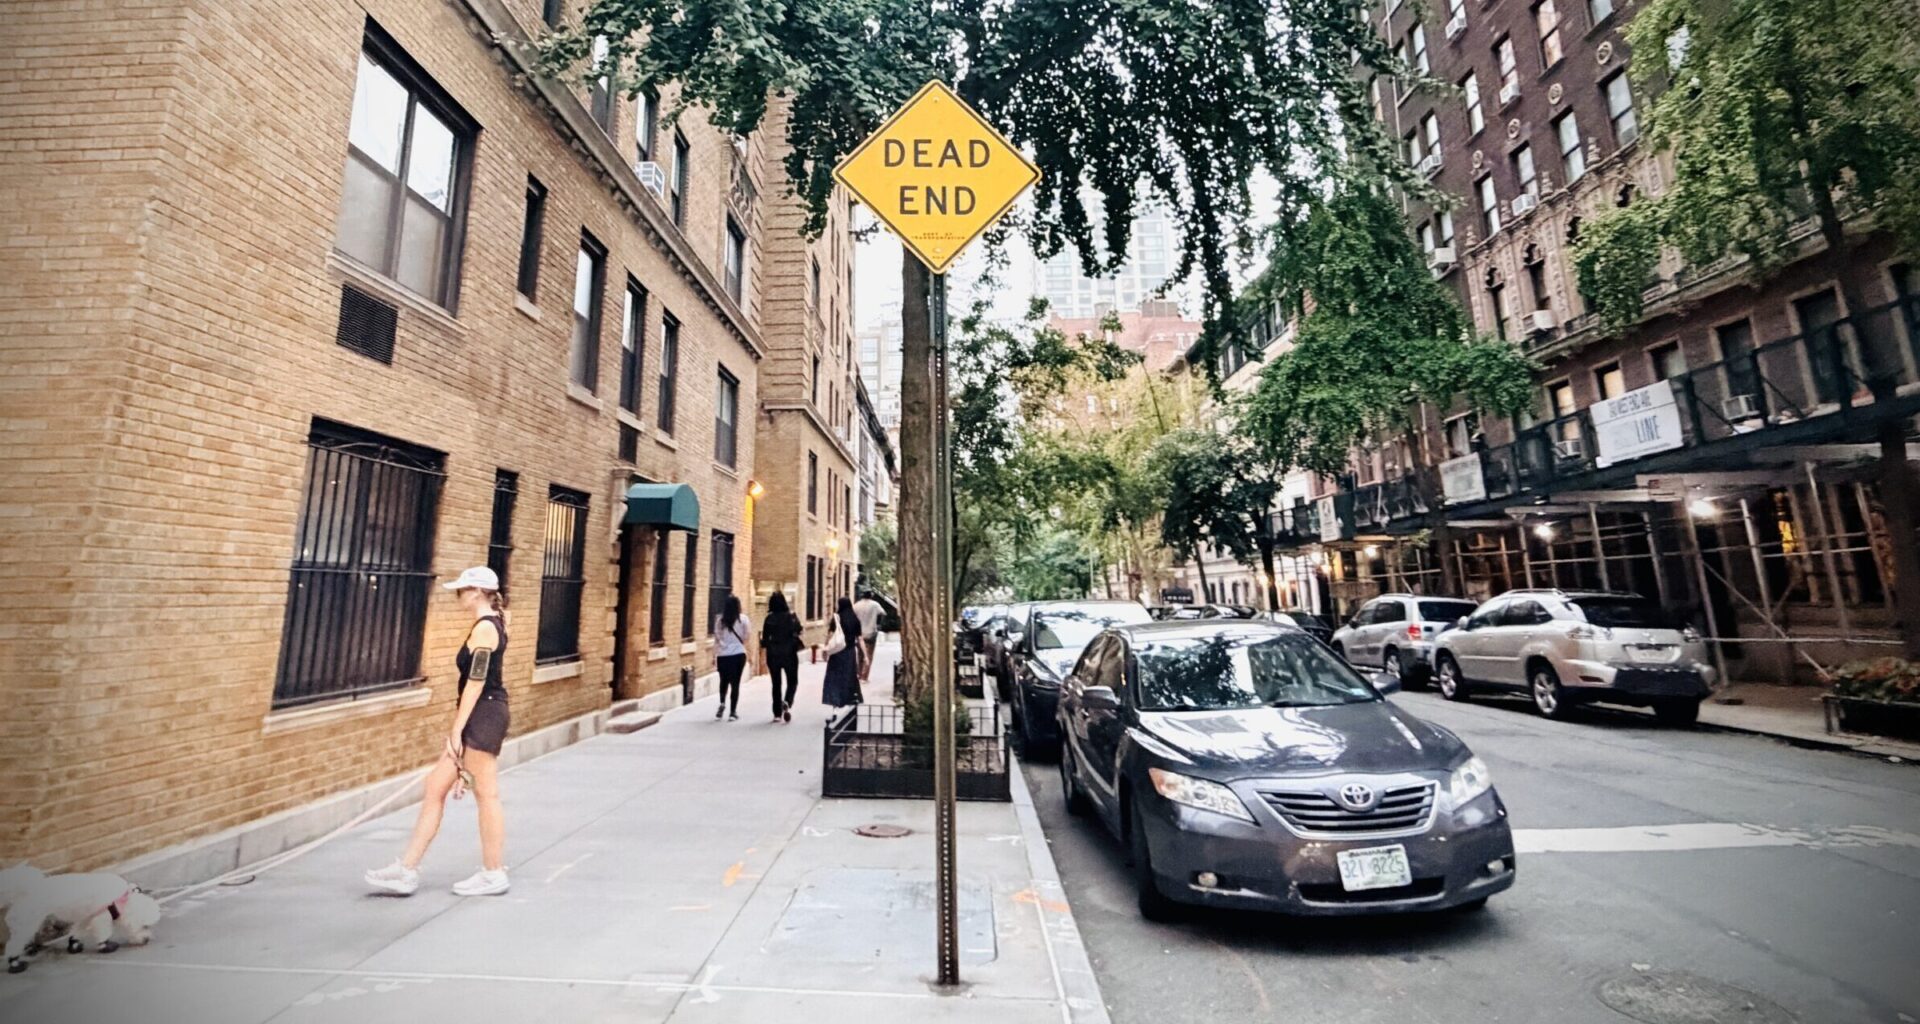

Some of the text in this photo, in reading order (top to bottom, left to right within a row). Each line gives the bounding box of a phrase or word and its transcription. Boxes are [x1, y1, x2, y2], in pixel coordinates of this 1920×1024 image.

[884, 138, 991, 168] DEAD
[899, 185, 976, 216] END
[1341, 858, 1365, 879] 321
